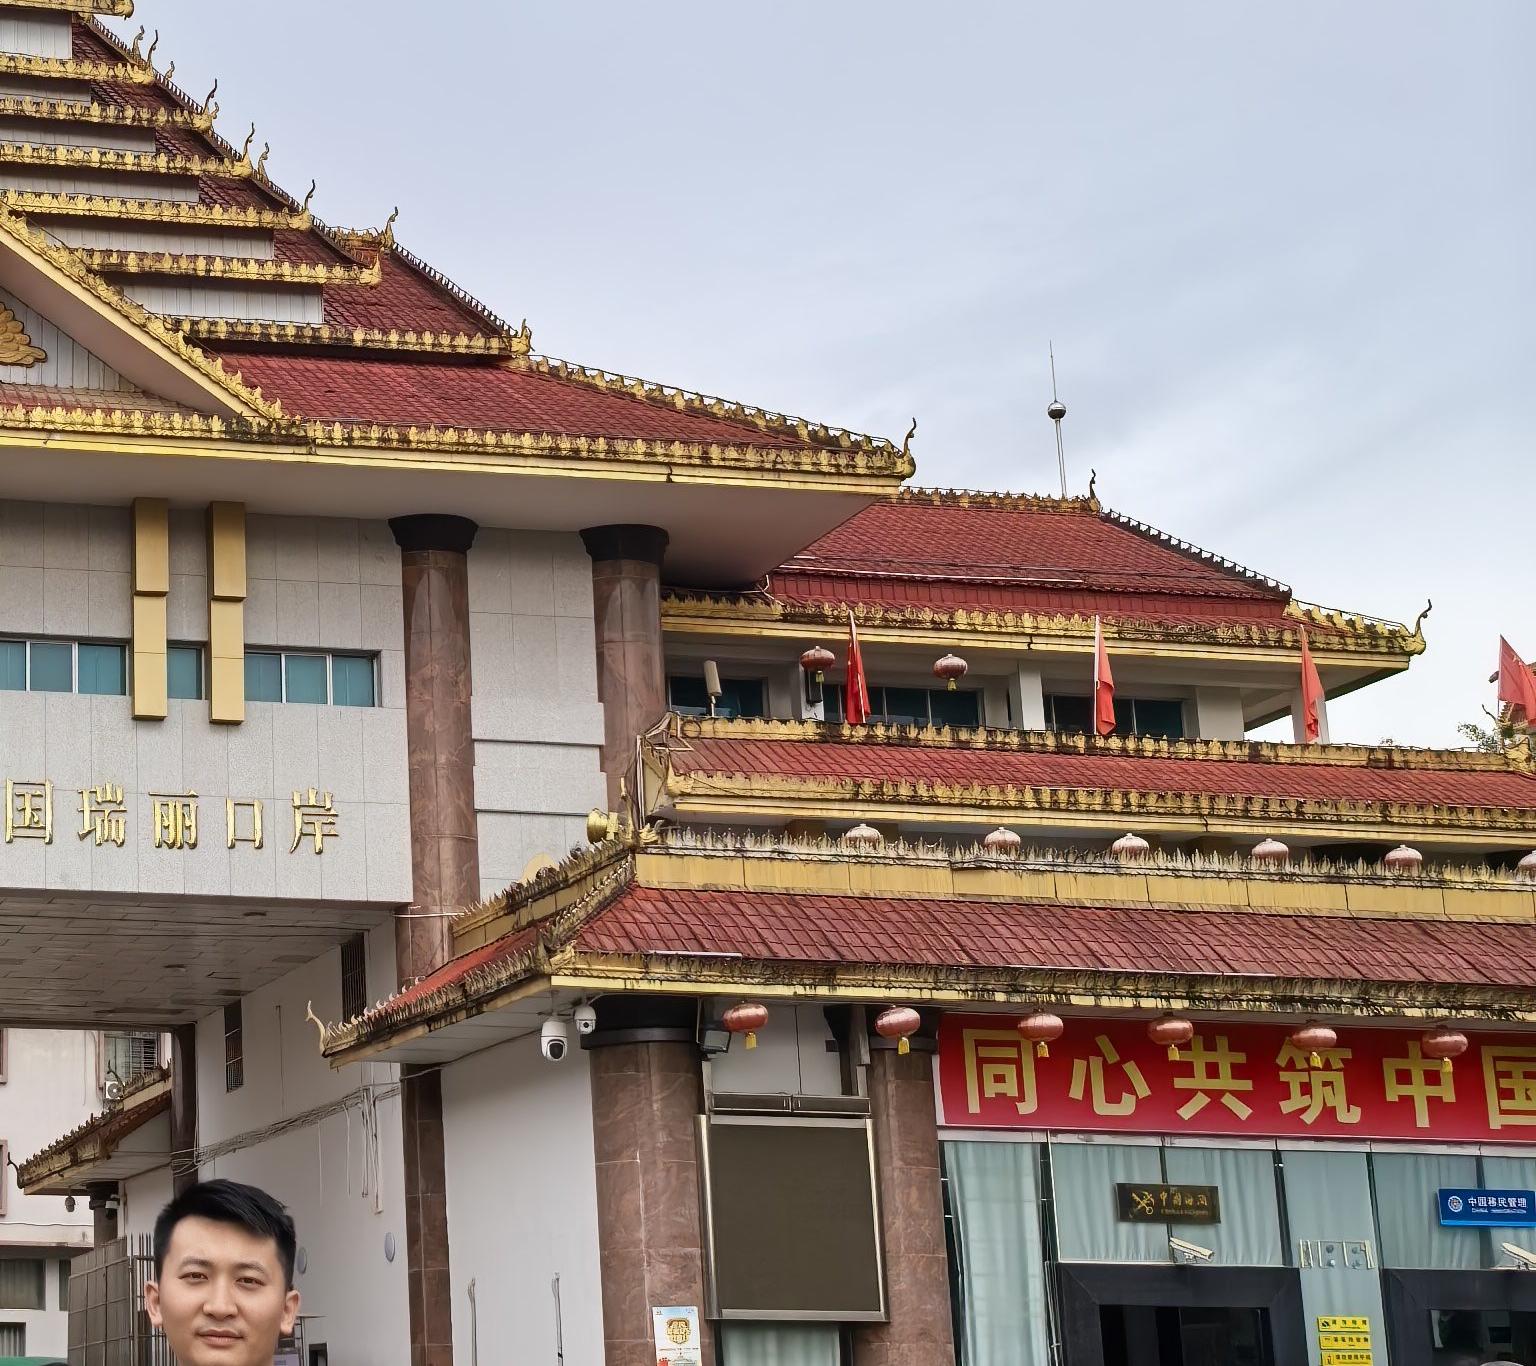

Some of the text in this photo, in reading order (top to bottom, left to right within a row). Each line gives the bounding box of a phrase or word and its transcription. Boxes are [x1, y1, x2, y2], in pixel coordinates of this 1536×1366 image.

[961, 1027, 1536, 1131] 同心共筑中国
